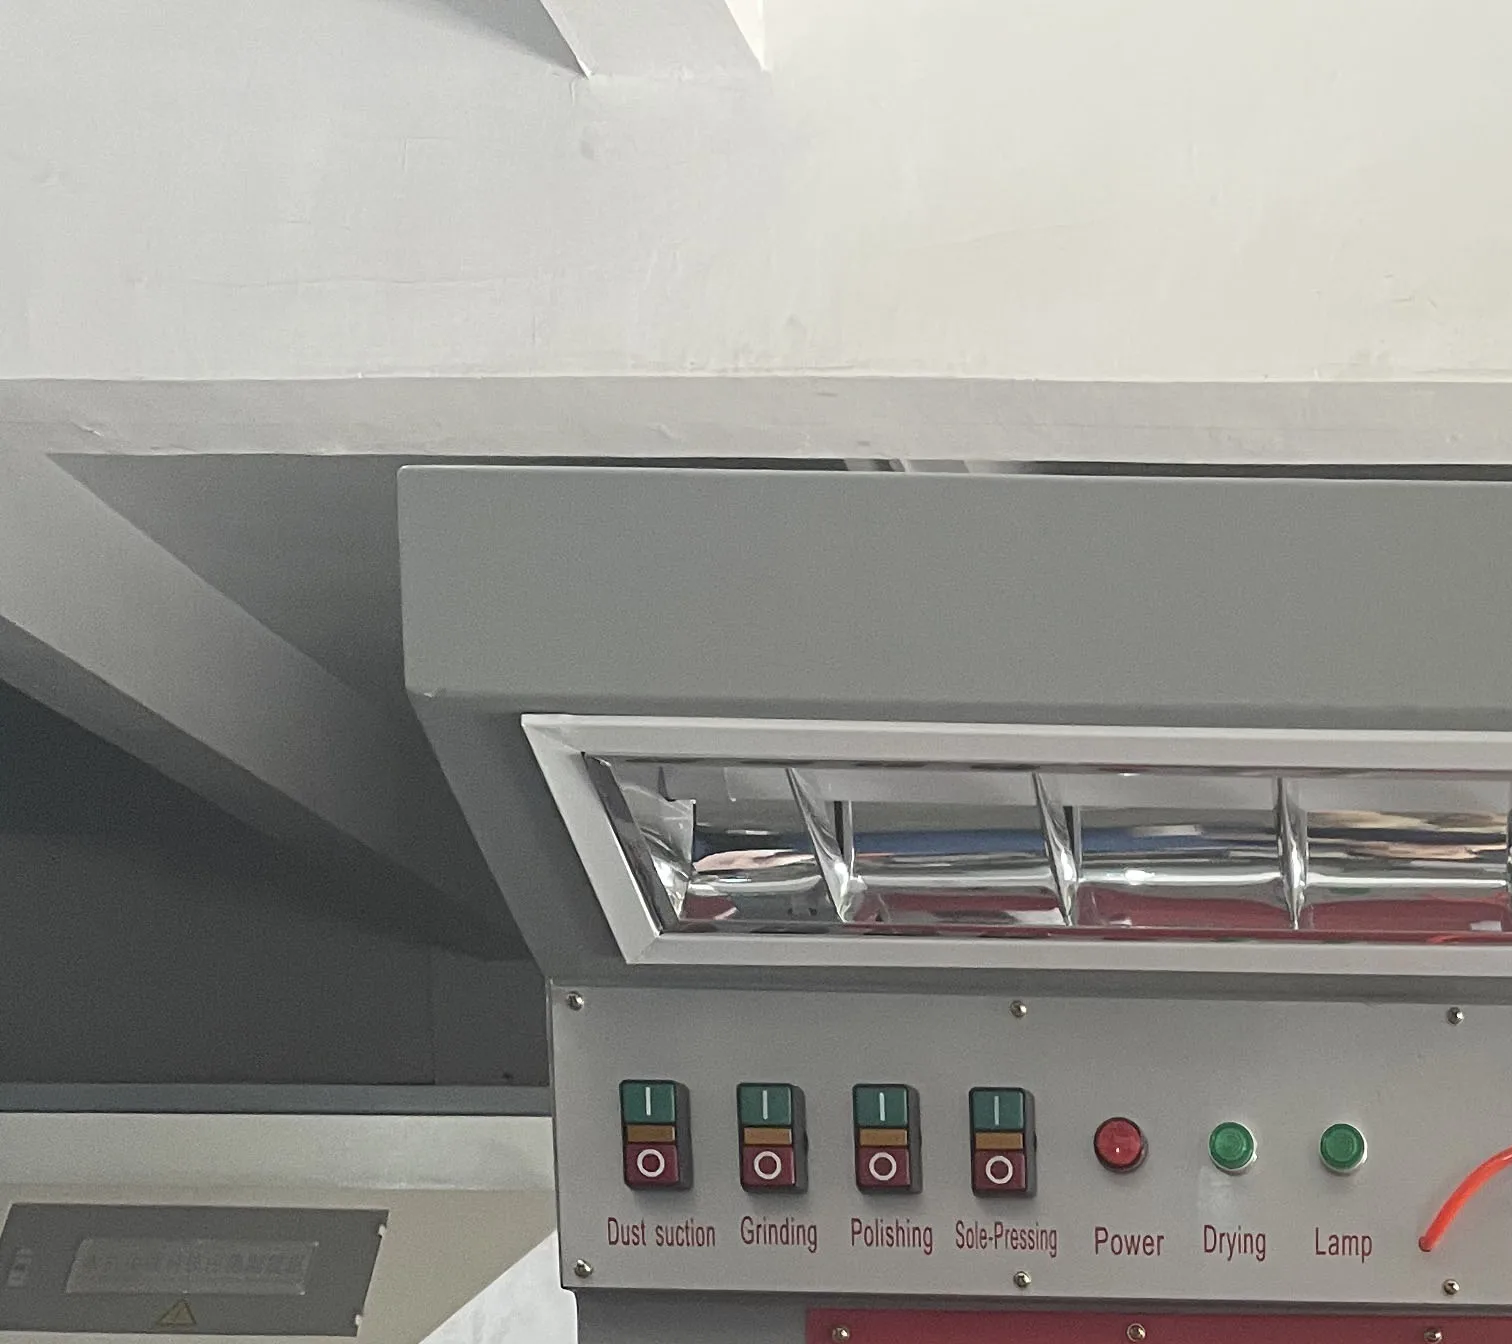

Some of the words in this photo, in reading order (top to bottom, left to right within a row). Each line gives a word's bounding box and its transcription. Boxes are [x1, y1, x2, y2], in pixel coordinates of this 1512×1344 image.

[608, 1217, 647, 1247] Dust
[655, 1217, 716, 1248] suction
[740, 1216, 818, 1253] Grinding
[850, 1217, 933, 1256] Polishing
[955, 1220, 1058, 1258] Sole-Pressing
[1095, 1226, 1165, 1256] Power
[1203, 1224, 1266, 1263] Drying
[1315, 1227, 1373, 1264] Lamp
